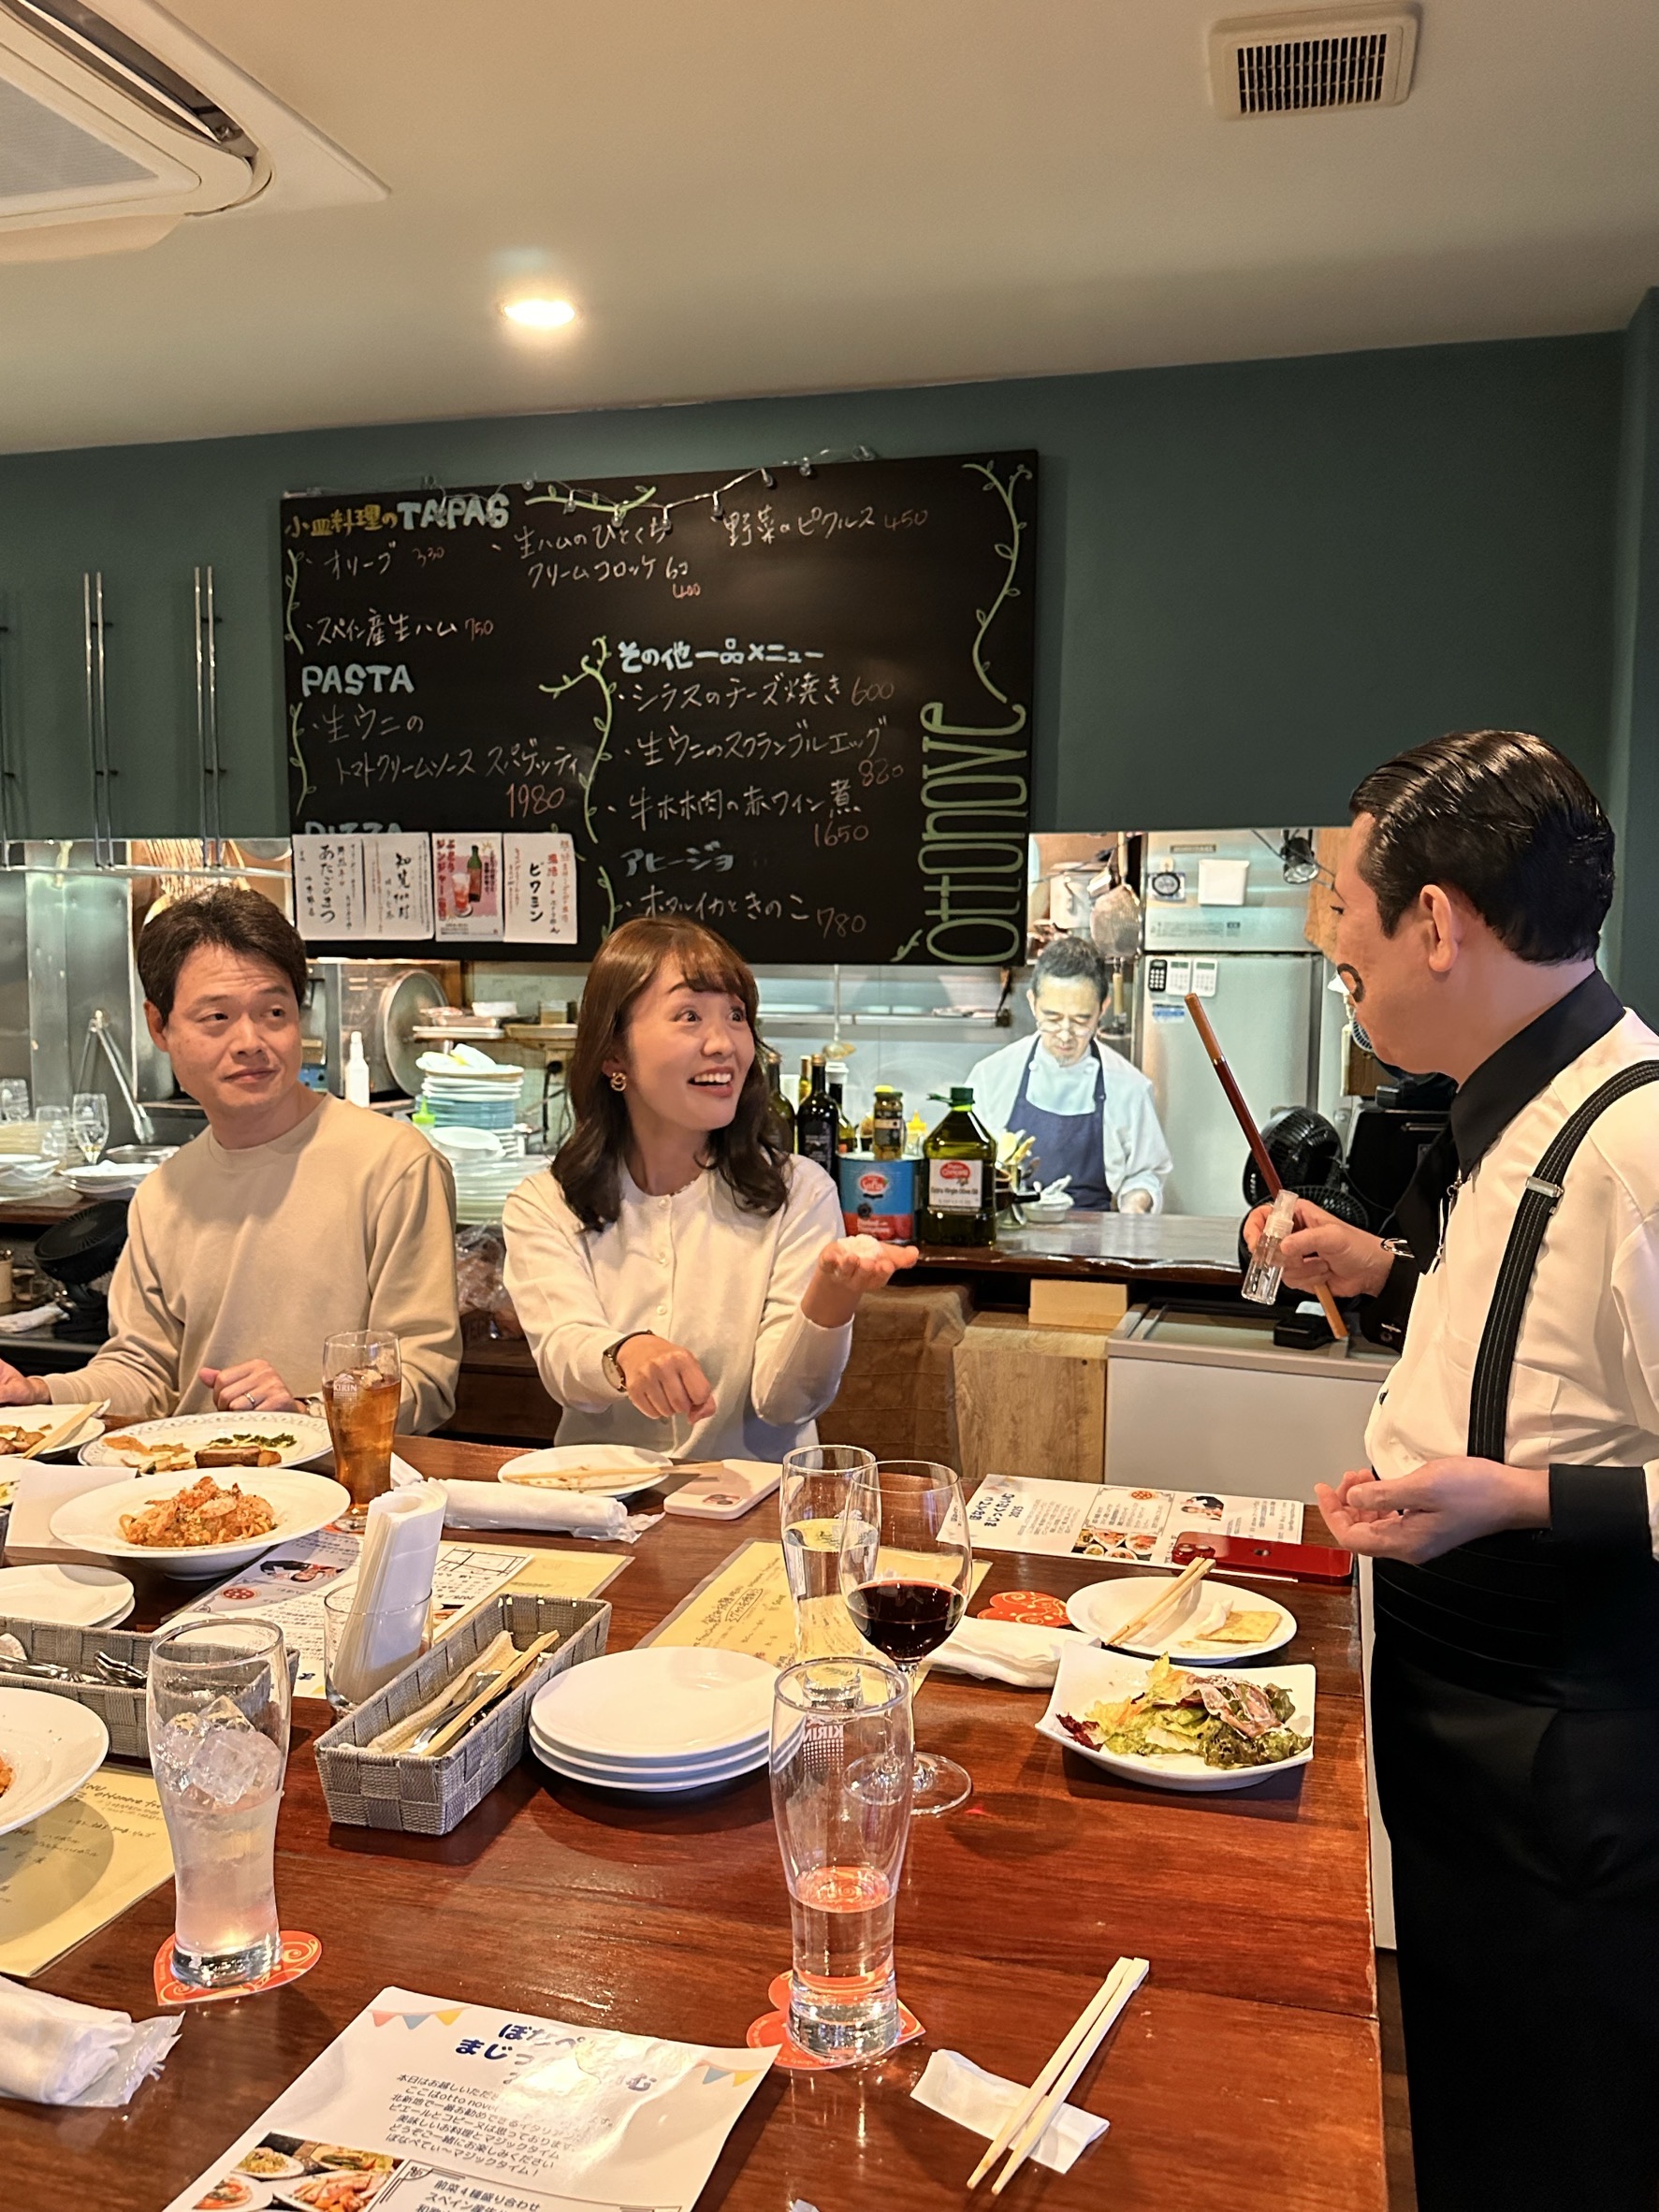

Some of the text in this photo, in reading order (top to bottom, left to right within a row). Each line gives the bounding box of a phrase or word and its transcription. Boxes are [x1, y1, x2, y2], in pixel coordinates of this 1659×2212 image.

[883, 509, 928, 531] 450
[324, 541, 397, 580] オリーブ
[672, 583, 701, 598] 400
[317, 608, 494, 647] スペイン産生ハム 750
[618, 637, 823, 673] その他一品メニュー
[301, 663, 415, 697] PASTA
[633, 671, 895, 711] シラスのチーズ焼き 600
[323, 704, 424, 743] 生ウニの
[505, 782, 565, 818] 1980
[814, 821, 868, 847] 1650
[620, 840, 735, 877] アヒージョ
[529, 862, 544, 922] ビワミン
[816, 907, 866, 939] 780
